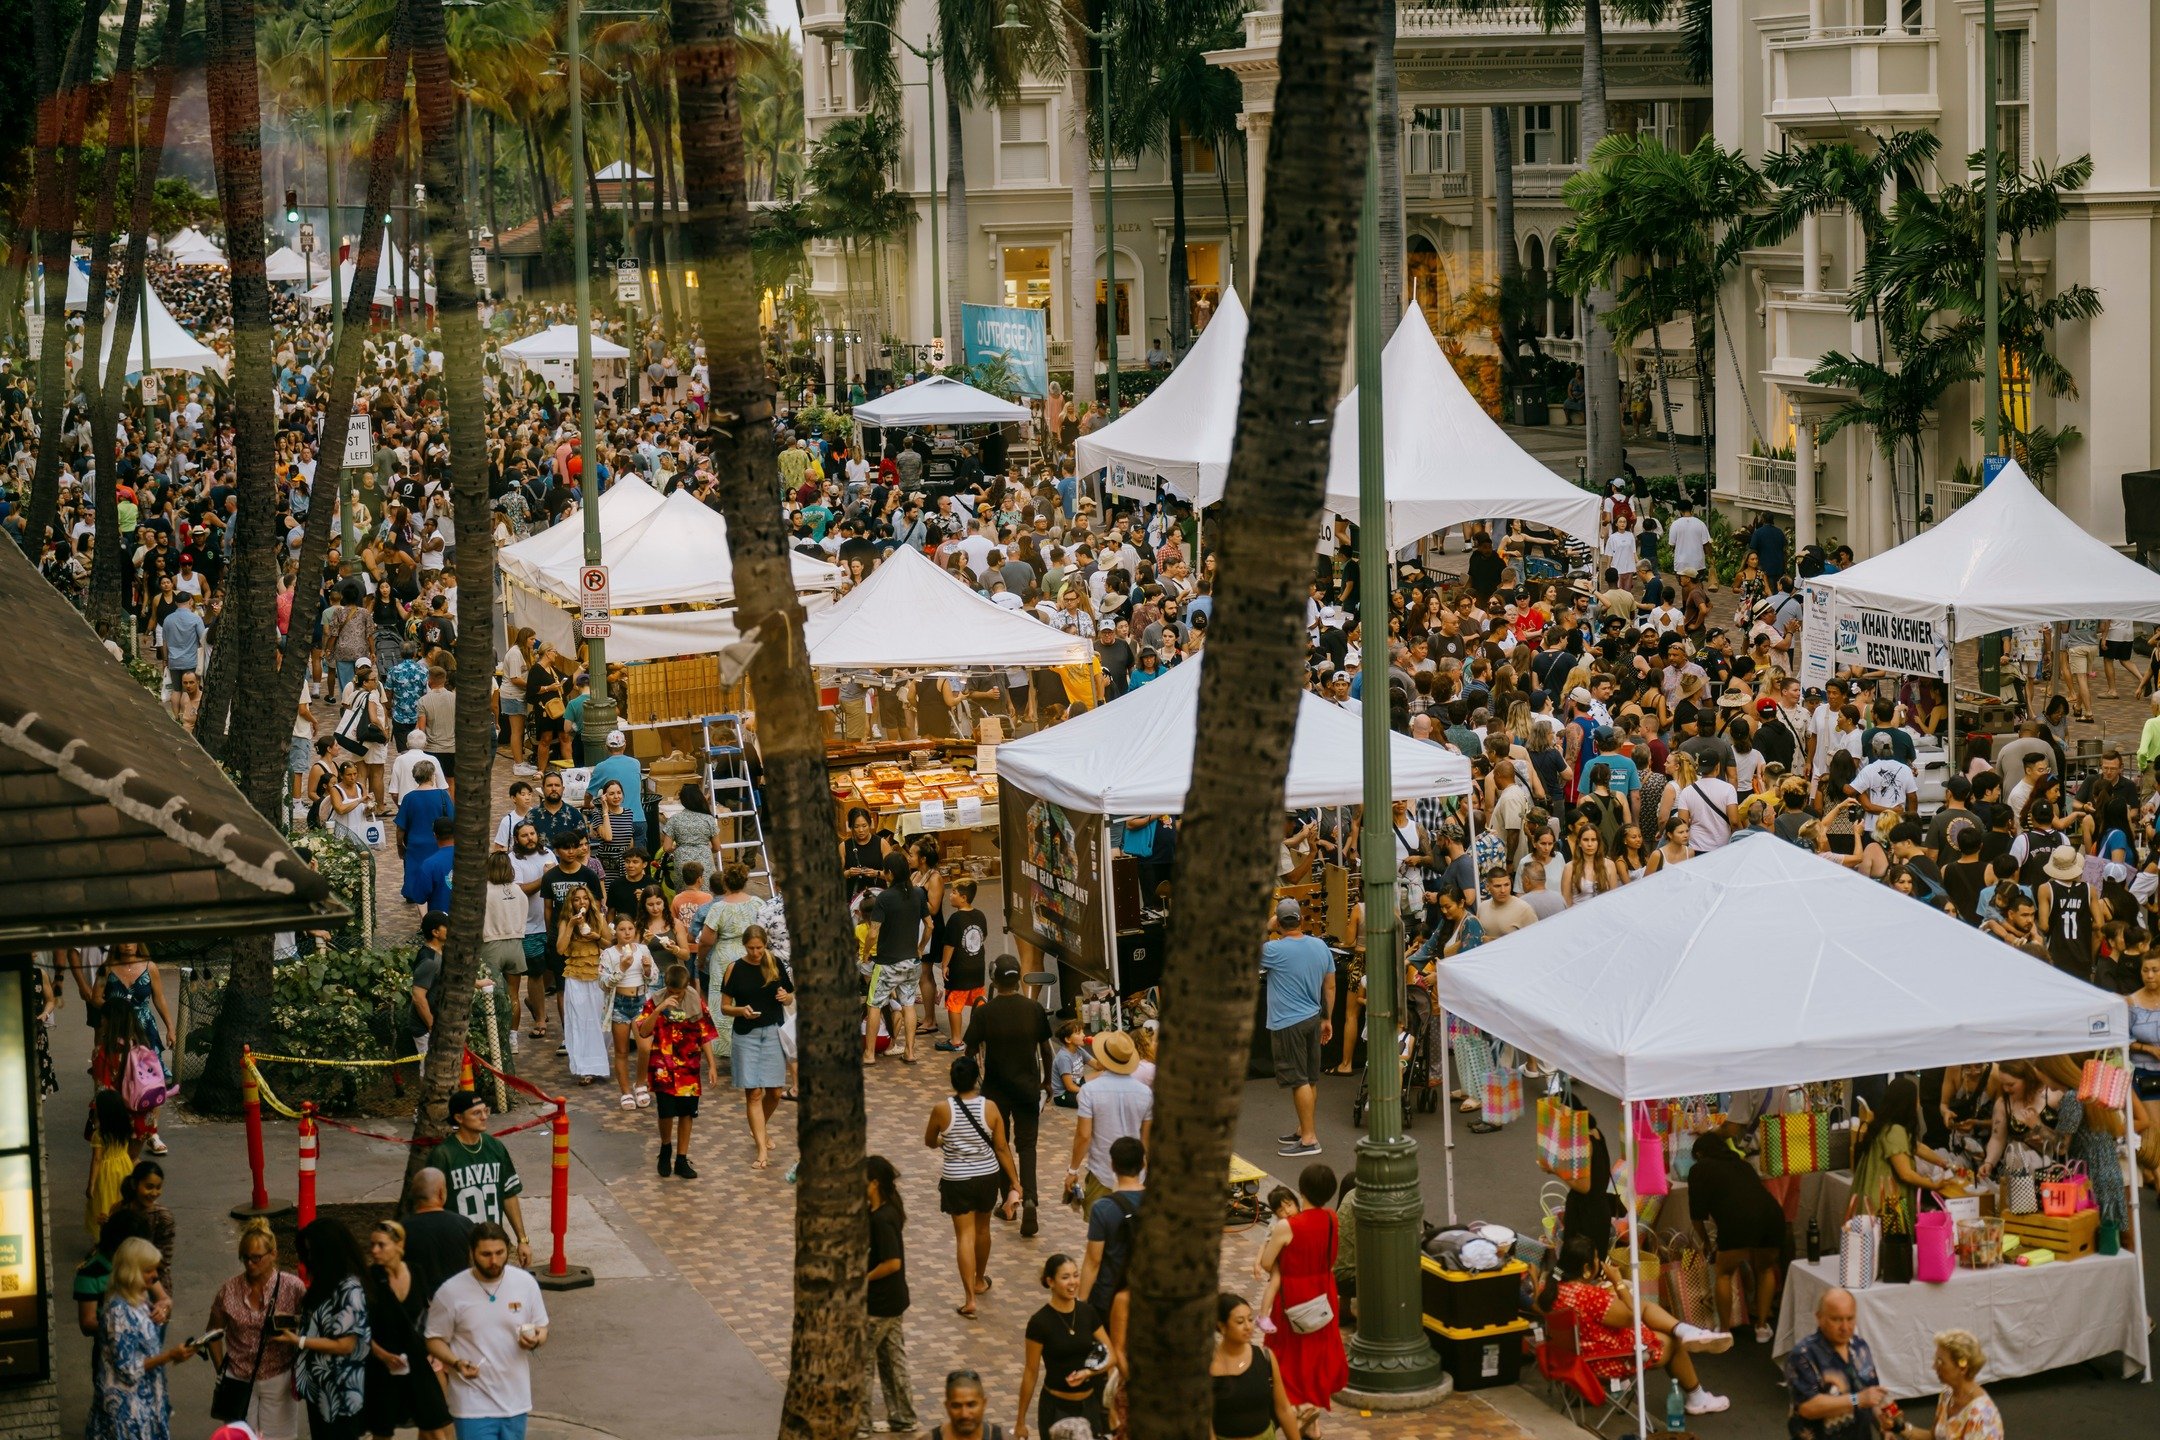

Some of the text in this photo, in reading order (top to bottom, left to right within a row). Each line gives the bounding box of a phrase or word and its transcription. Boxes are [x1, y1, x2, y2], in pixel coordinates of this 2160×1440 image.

[977, 320, 1034, 352] OUTRIGGER
[349, 422, 366, 430] ANE
[348, 436, 359, 447] ST
[351, 452, 368, 460] LEFT
[1986, 457, 2006, 465] TROLLEY
[1990, 463, 2003, 471] STOP
[1126, 470, 1156, 491] SUN NOODLE
[585, 626, 609, 635] BEGIN
[1839, 619, 1860, 634] SPAM
[1861, 612, 1934, 645] KHAN SKEWER
[1840, 633, 1857, 648] JAM
[1867, 642, 1931, 673] RESTAURANT
[2061, 911, 2078, 939] 11
[2050, 1190, 2066, 1207] HI
